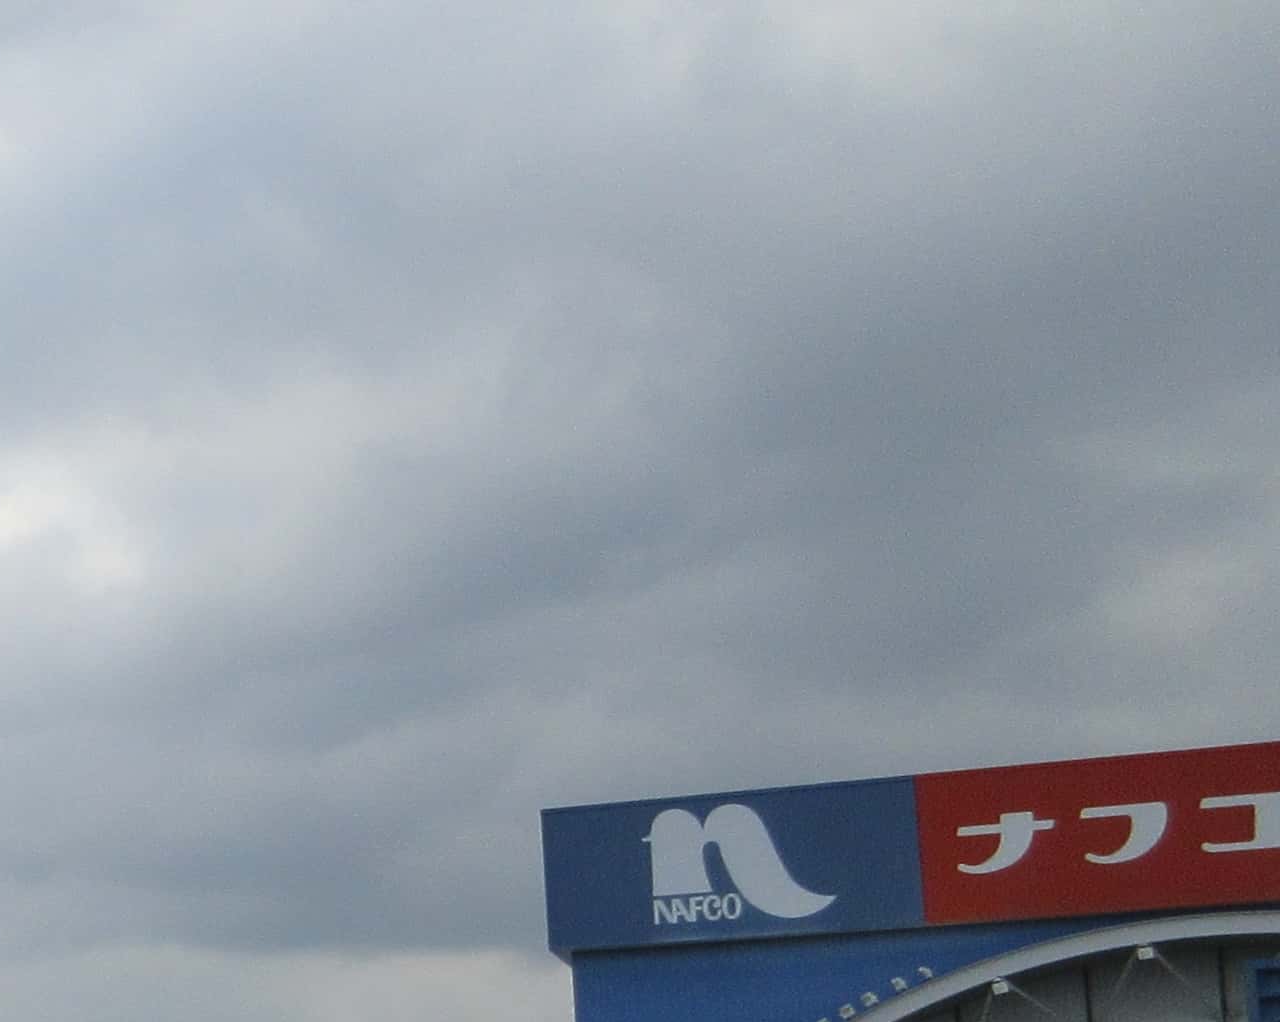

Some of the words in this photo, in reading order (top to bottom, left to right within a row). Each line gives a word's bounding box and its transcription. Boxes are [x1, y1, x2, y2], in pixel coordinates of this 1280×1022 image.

[956, 791, 1280, 875] ナフコ
[653, 892, 742, 926] NAFCO
